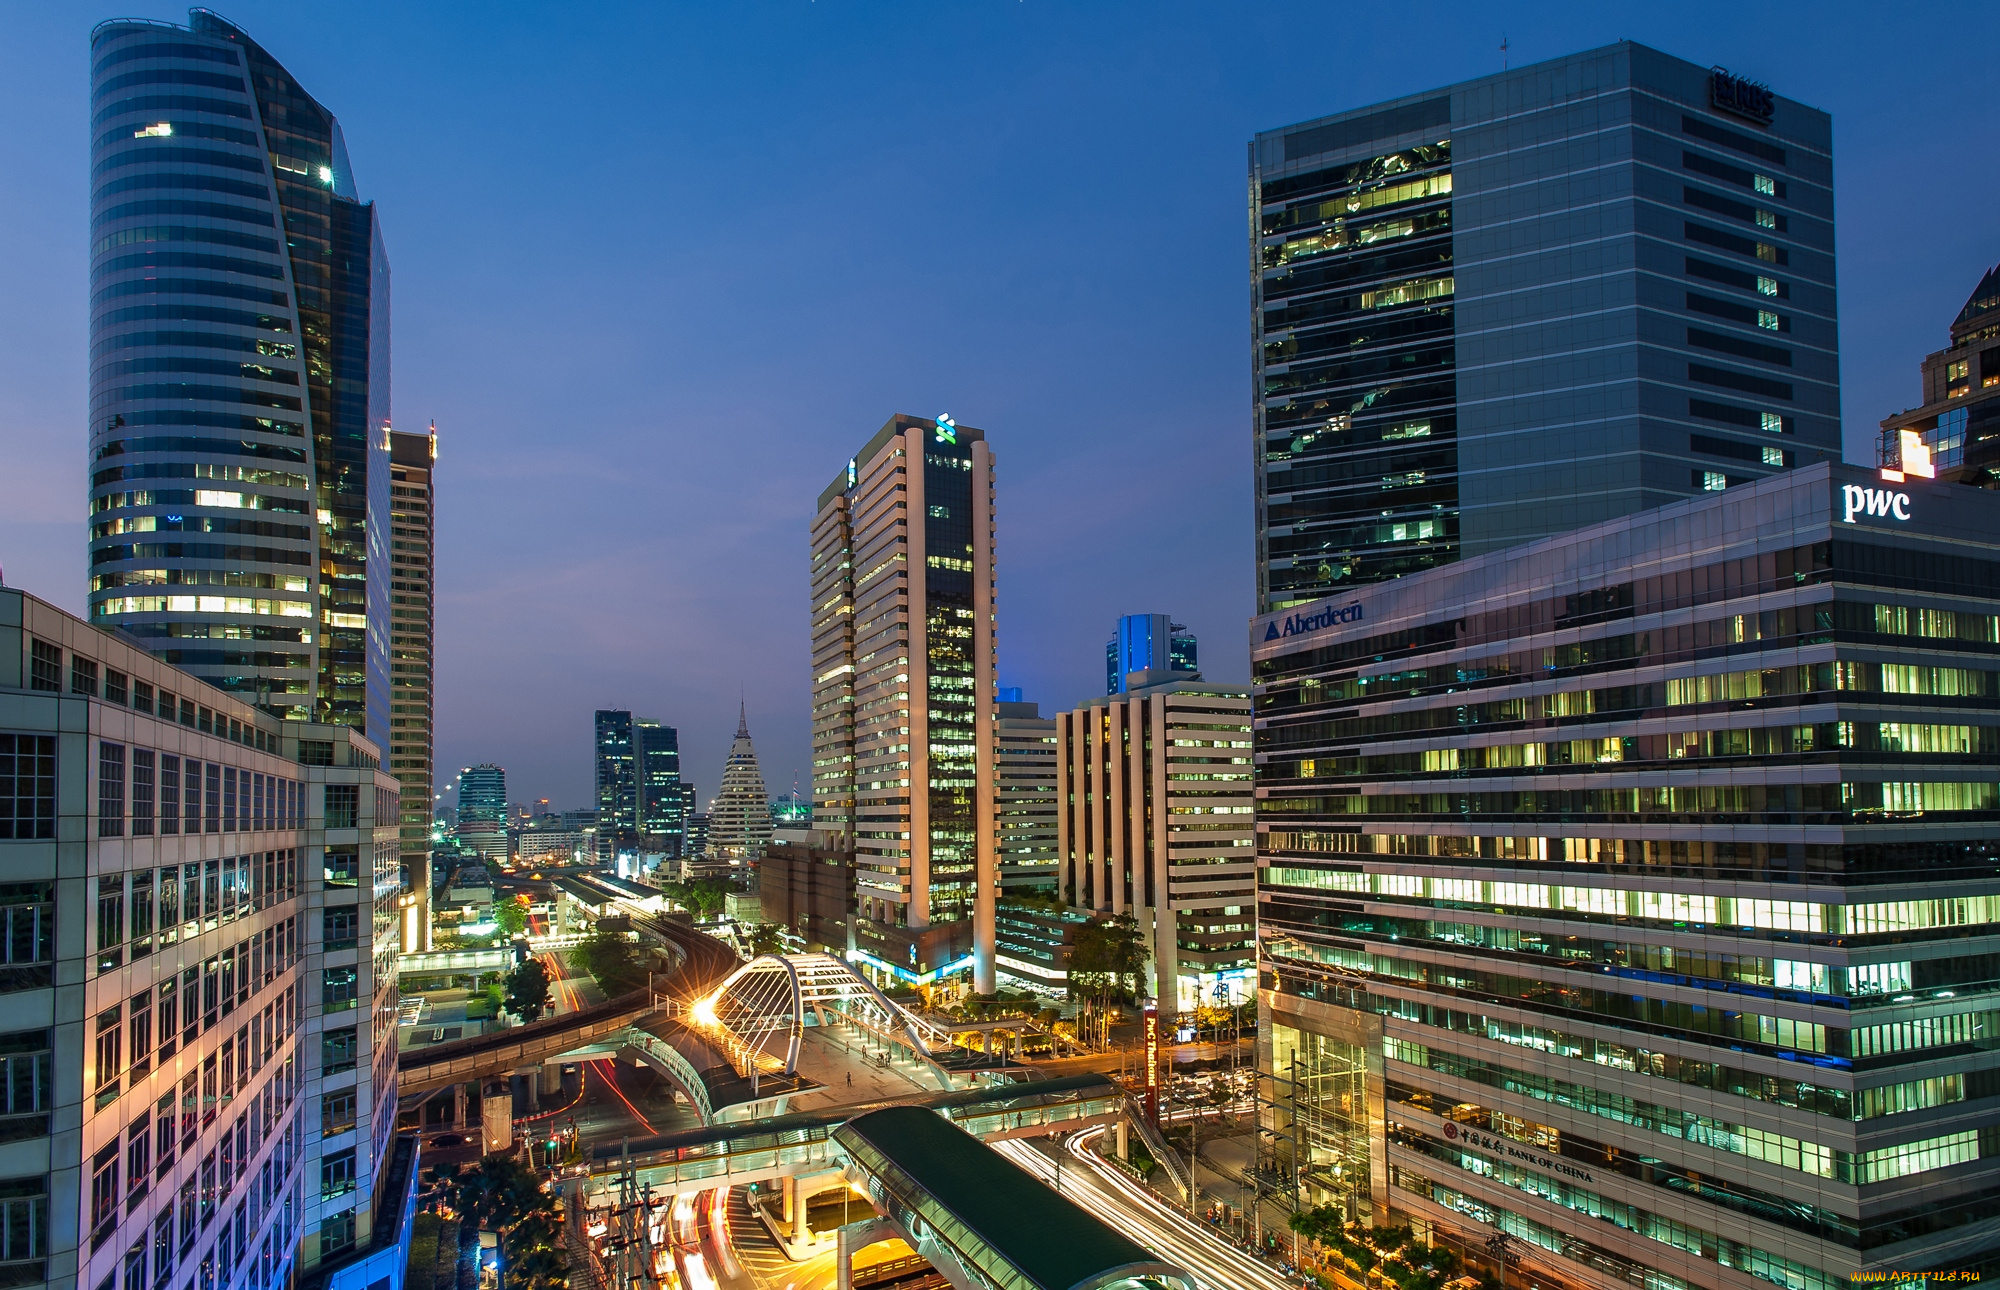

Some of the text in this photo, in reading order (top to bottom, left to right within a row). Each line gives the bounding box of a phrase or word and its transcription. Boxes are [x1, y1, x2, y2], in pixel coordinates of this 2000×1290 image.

[1842, 484, 1911, 524] pwc
[1146, 1017, 1156, 1040] PwC
[1507, 1146, 1594, 1184] BANK OF CHINA
